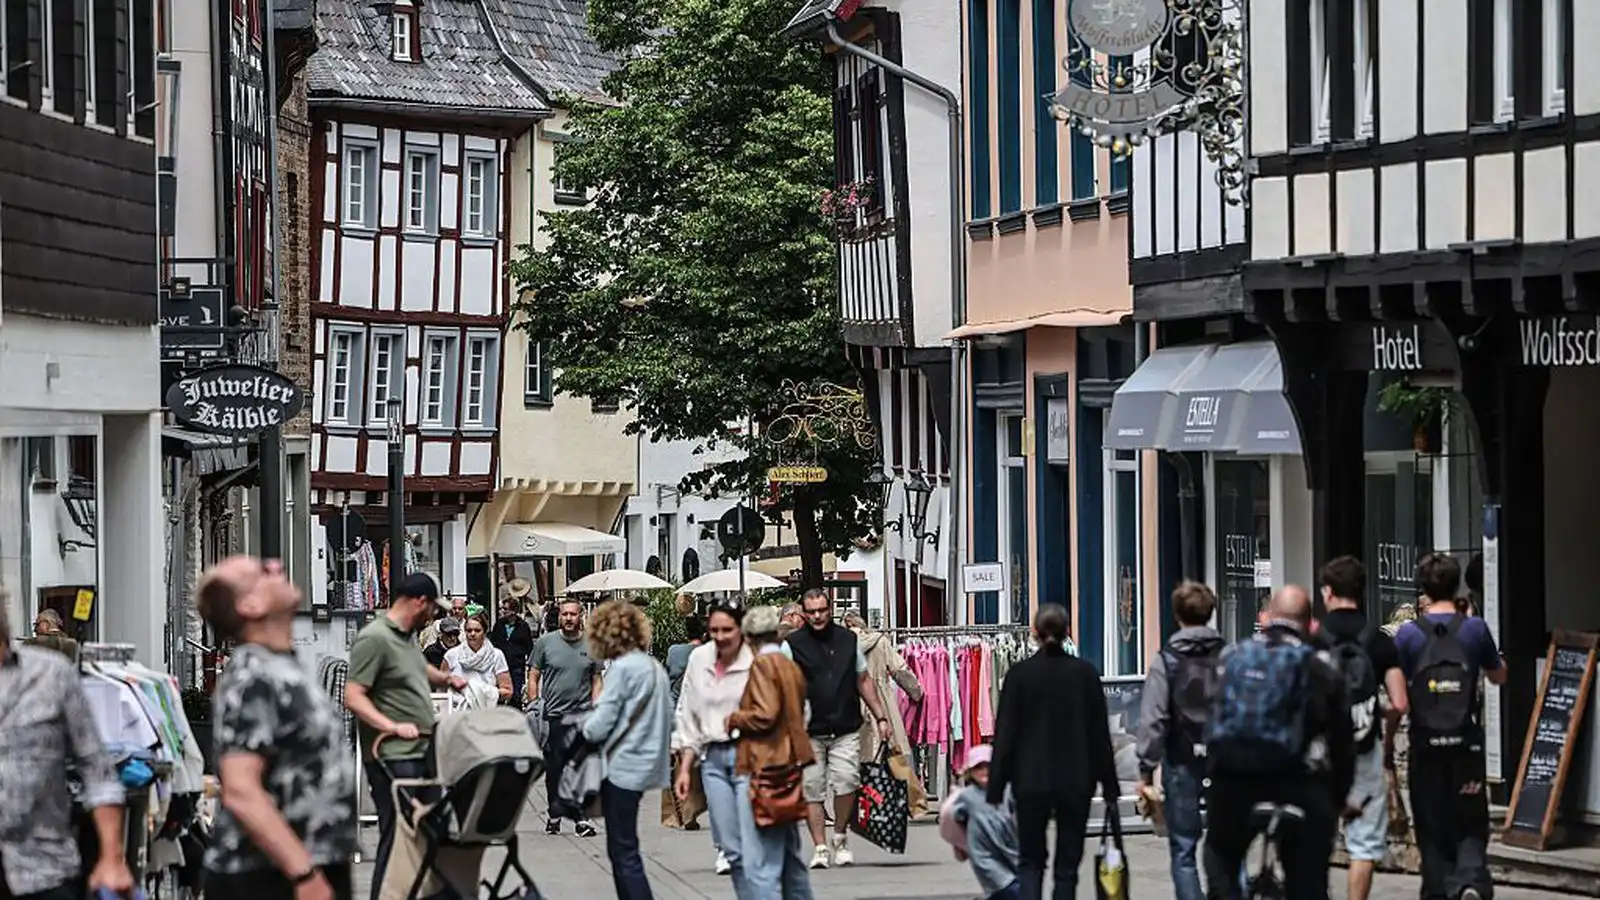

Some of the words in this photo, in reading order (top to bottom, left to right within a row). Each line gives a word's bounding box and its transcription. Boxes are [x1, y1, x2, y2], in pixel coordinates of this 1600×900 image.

[1072, 91, 1167, 118] HOTEL
[1373, 324, 1422, 370] Hotel
[178, 376, 294, 406] Juwelier
[190, 402, 281, 430] Kälble
[1186, 396, 1222, 426] ESTELLA
[972, 572, 996, 583] SALE
